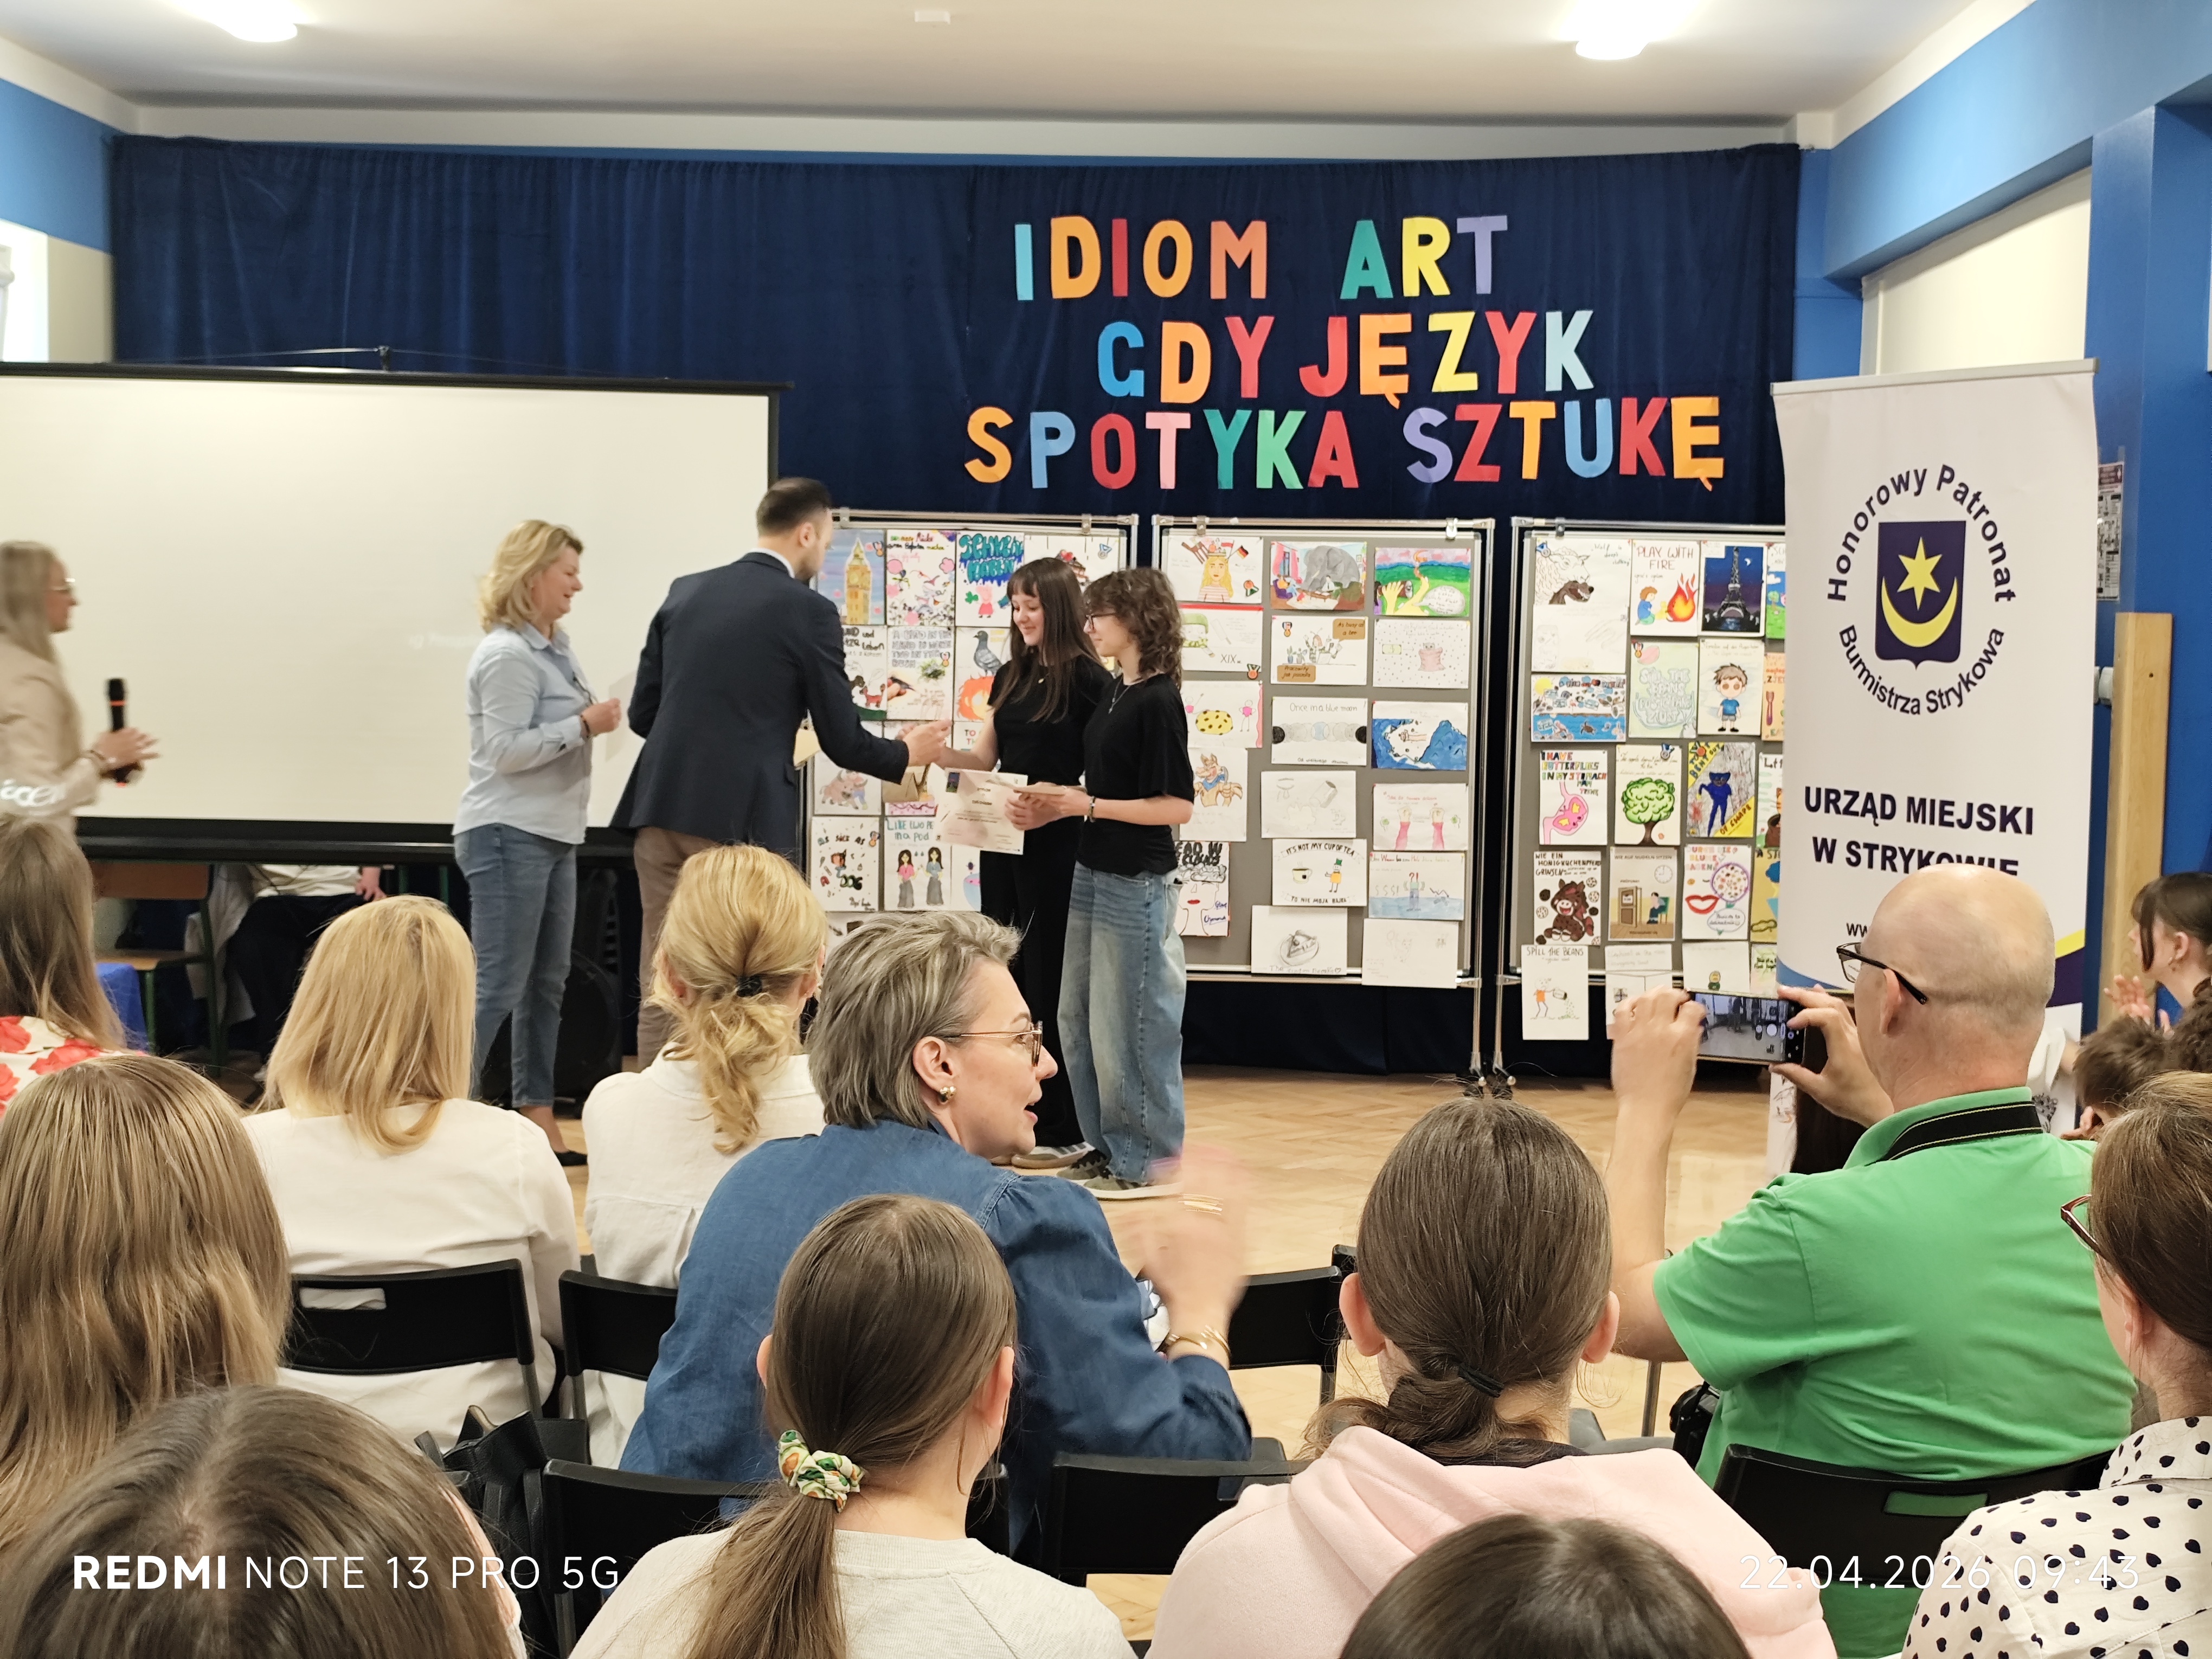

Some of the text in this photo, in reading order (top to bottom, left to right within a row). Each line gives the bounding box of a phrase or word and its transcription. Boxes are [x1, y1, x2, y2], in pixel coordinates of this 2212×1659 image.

[1014, 215, 1508, 301] IDIOM ART
[1097, 310, 1594, 409] GDY JĘZYK
[963, 396, 1724, 491] SPOTYKA SZTUKĘ
[1827, 467, 1928, 602] Honorowy
[1936, 464, 2016, 602] Patronat
[1637, 545, 1694, 558] PLAY WITH
[1649, 559, 1676, 570] FIRE
[1838, 624, 2005, 716] Burmistrza Strykowa
[1289, 702, 1308, 712] Once
[1326, 704, 1339, 712] blue
[1546, 751, 1573, 761] HAVE
[1542, 772, 1554, 781] IN
[1555, 772, 1568, 781] MY
[1804, 786, 2034, 836] URZĄD MIEJSKI
[1812, 836, 1837, 864] W
[1527, 946, 1584, 956] SPILL THE BEANS
